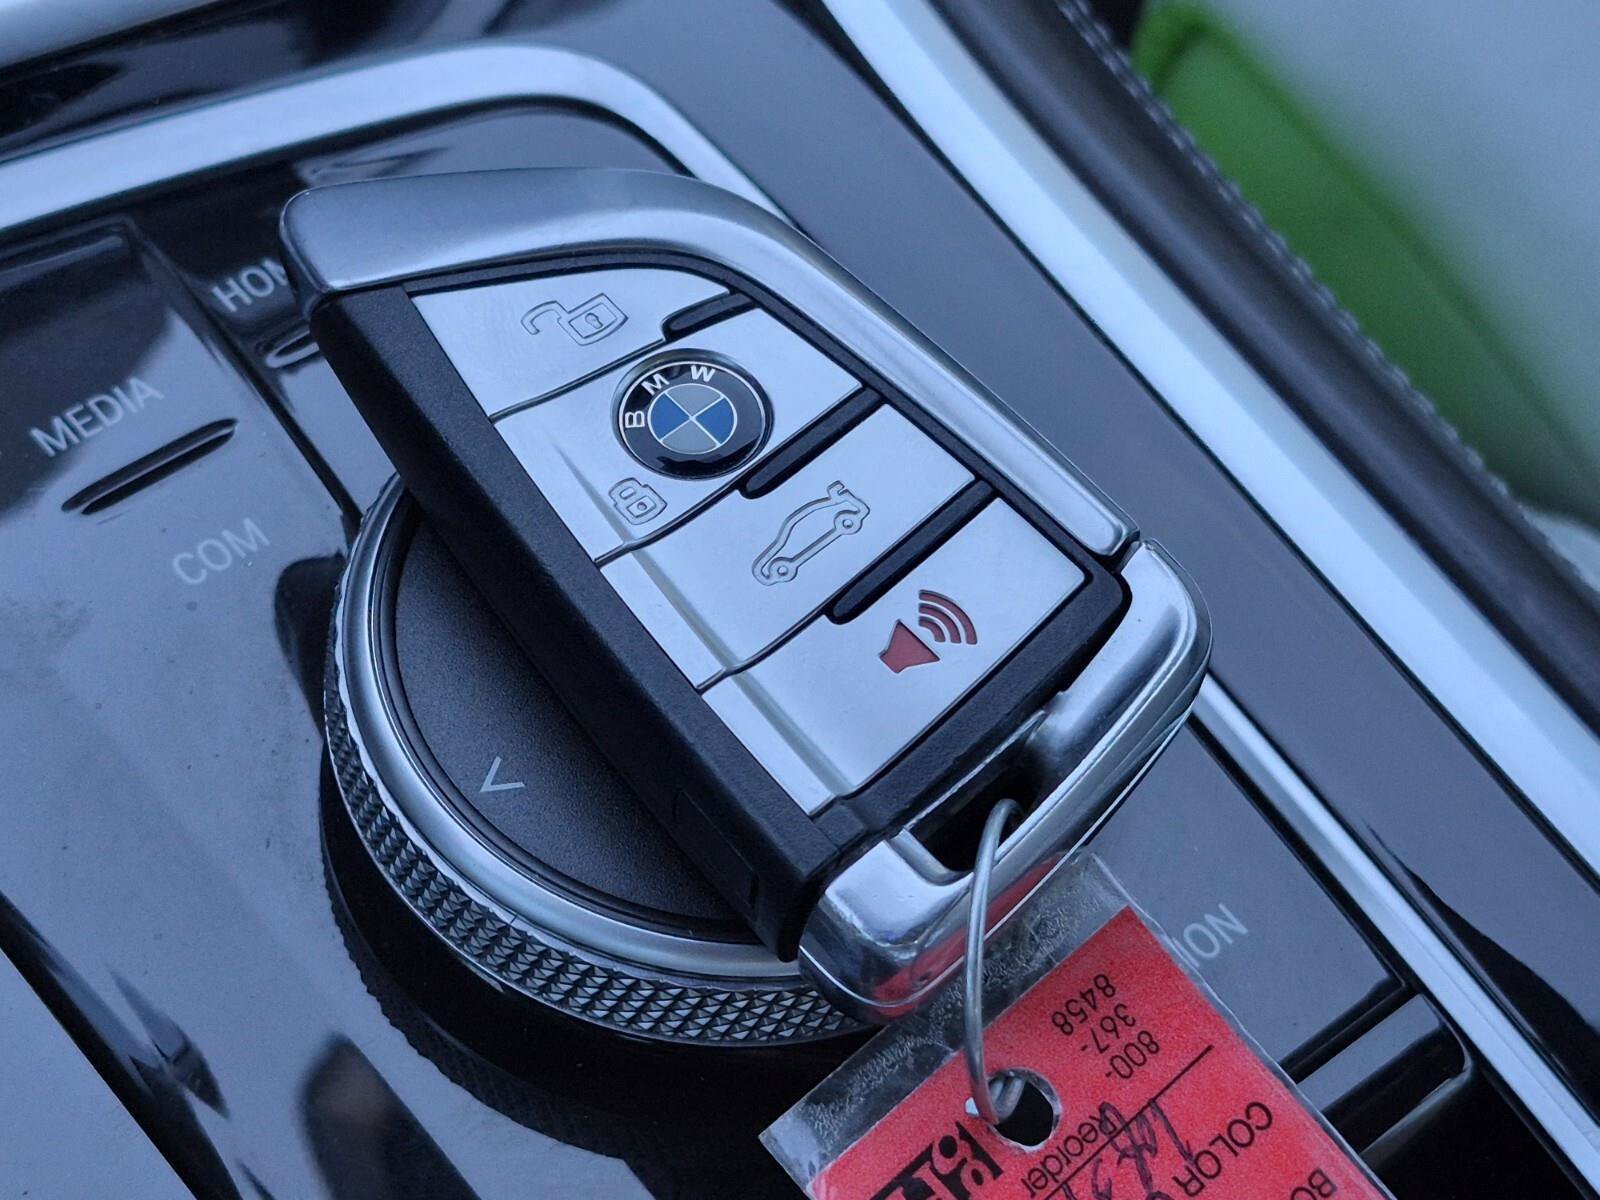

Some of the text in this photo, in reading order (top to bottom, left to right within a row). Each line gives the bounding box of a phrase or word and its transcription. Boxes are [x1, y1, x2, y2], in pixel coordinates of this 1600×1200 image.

[29, 377, 164, 458] MEDIA
[625, 365, 716, 429] BMW
[172, 517, 271, 585] COM
[1170, 903, 1249, 969] ION
[1051, 974, 1116, 1036] 8458
[1080, 1003, 1136, 1054] 367-
[1105, 1030, 1160, 1079] 800-
[1021, 1114, 1118, 1199] Reorder
[1172, 1101, 1273, 1198] COLOR
